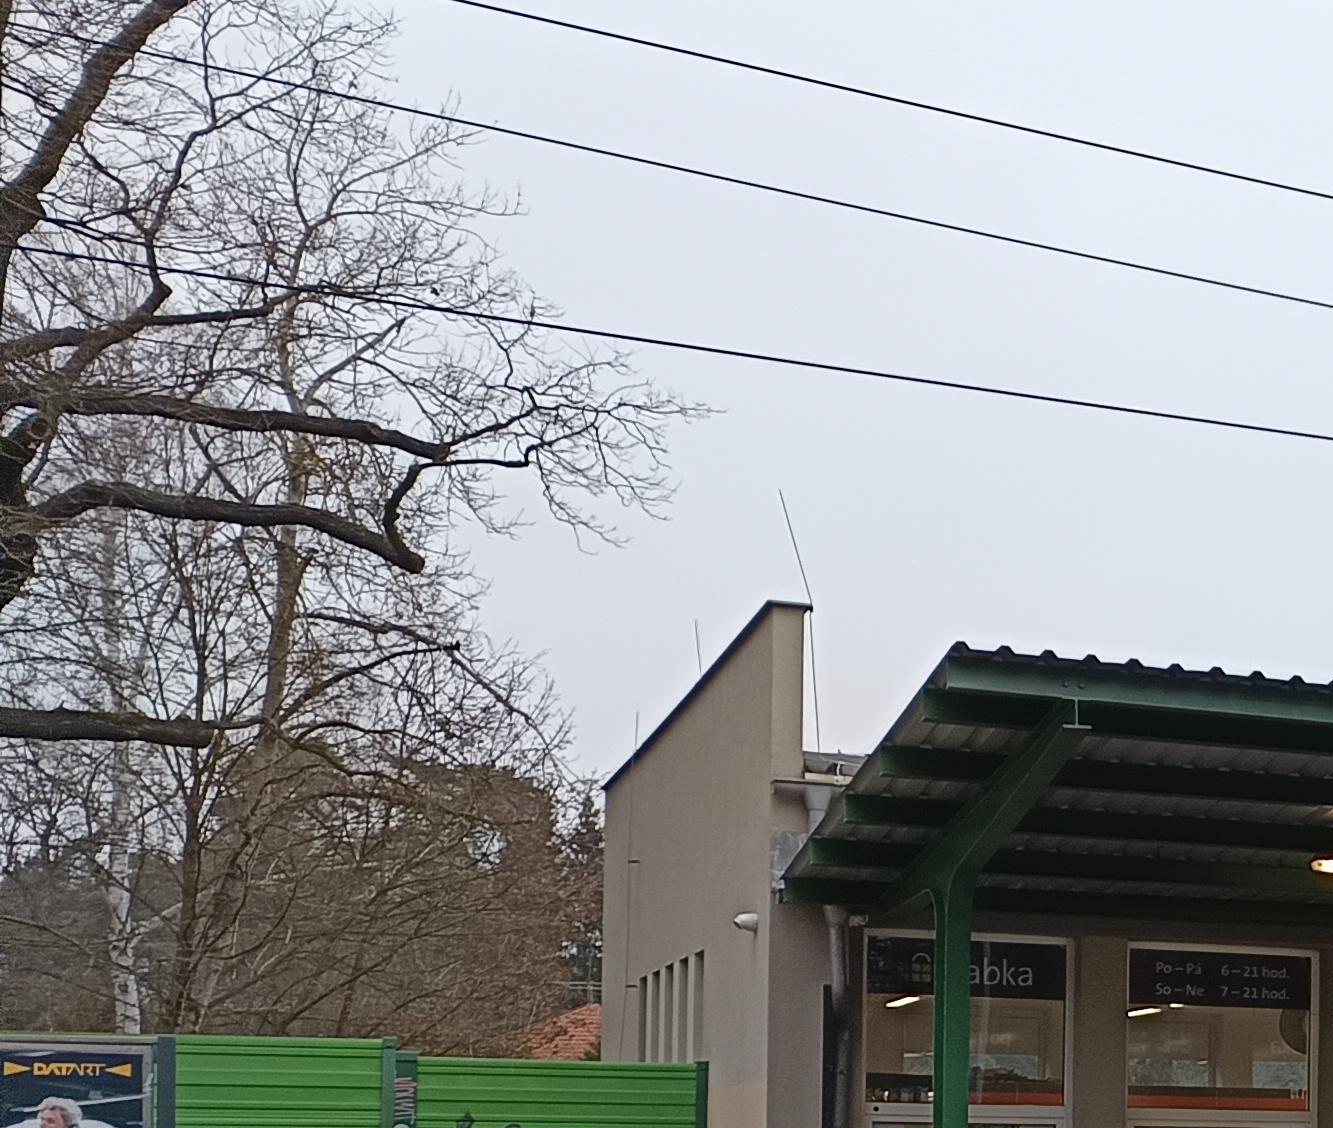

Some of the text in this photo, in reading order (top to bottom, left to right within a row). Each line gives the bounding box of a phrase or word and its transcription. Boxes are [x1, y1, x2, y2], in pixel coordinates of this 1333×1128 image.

[967, 957, 1033, 987] abka
[1221, 965, 1229, 976] 6
[1244, 966, 1258, 978] 21
[1262, 967, 1290, 979] hod.
[1156, 983, 1172, 996] So
[1186, 984, 1204, 997] Ne
[1220, 986, 1228, 997] 7
[1243, 987, 1258, 999] 21
[1262, 987, 1290, 1000] hod.
[32, 1062, 107, 1077] DATART
